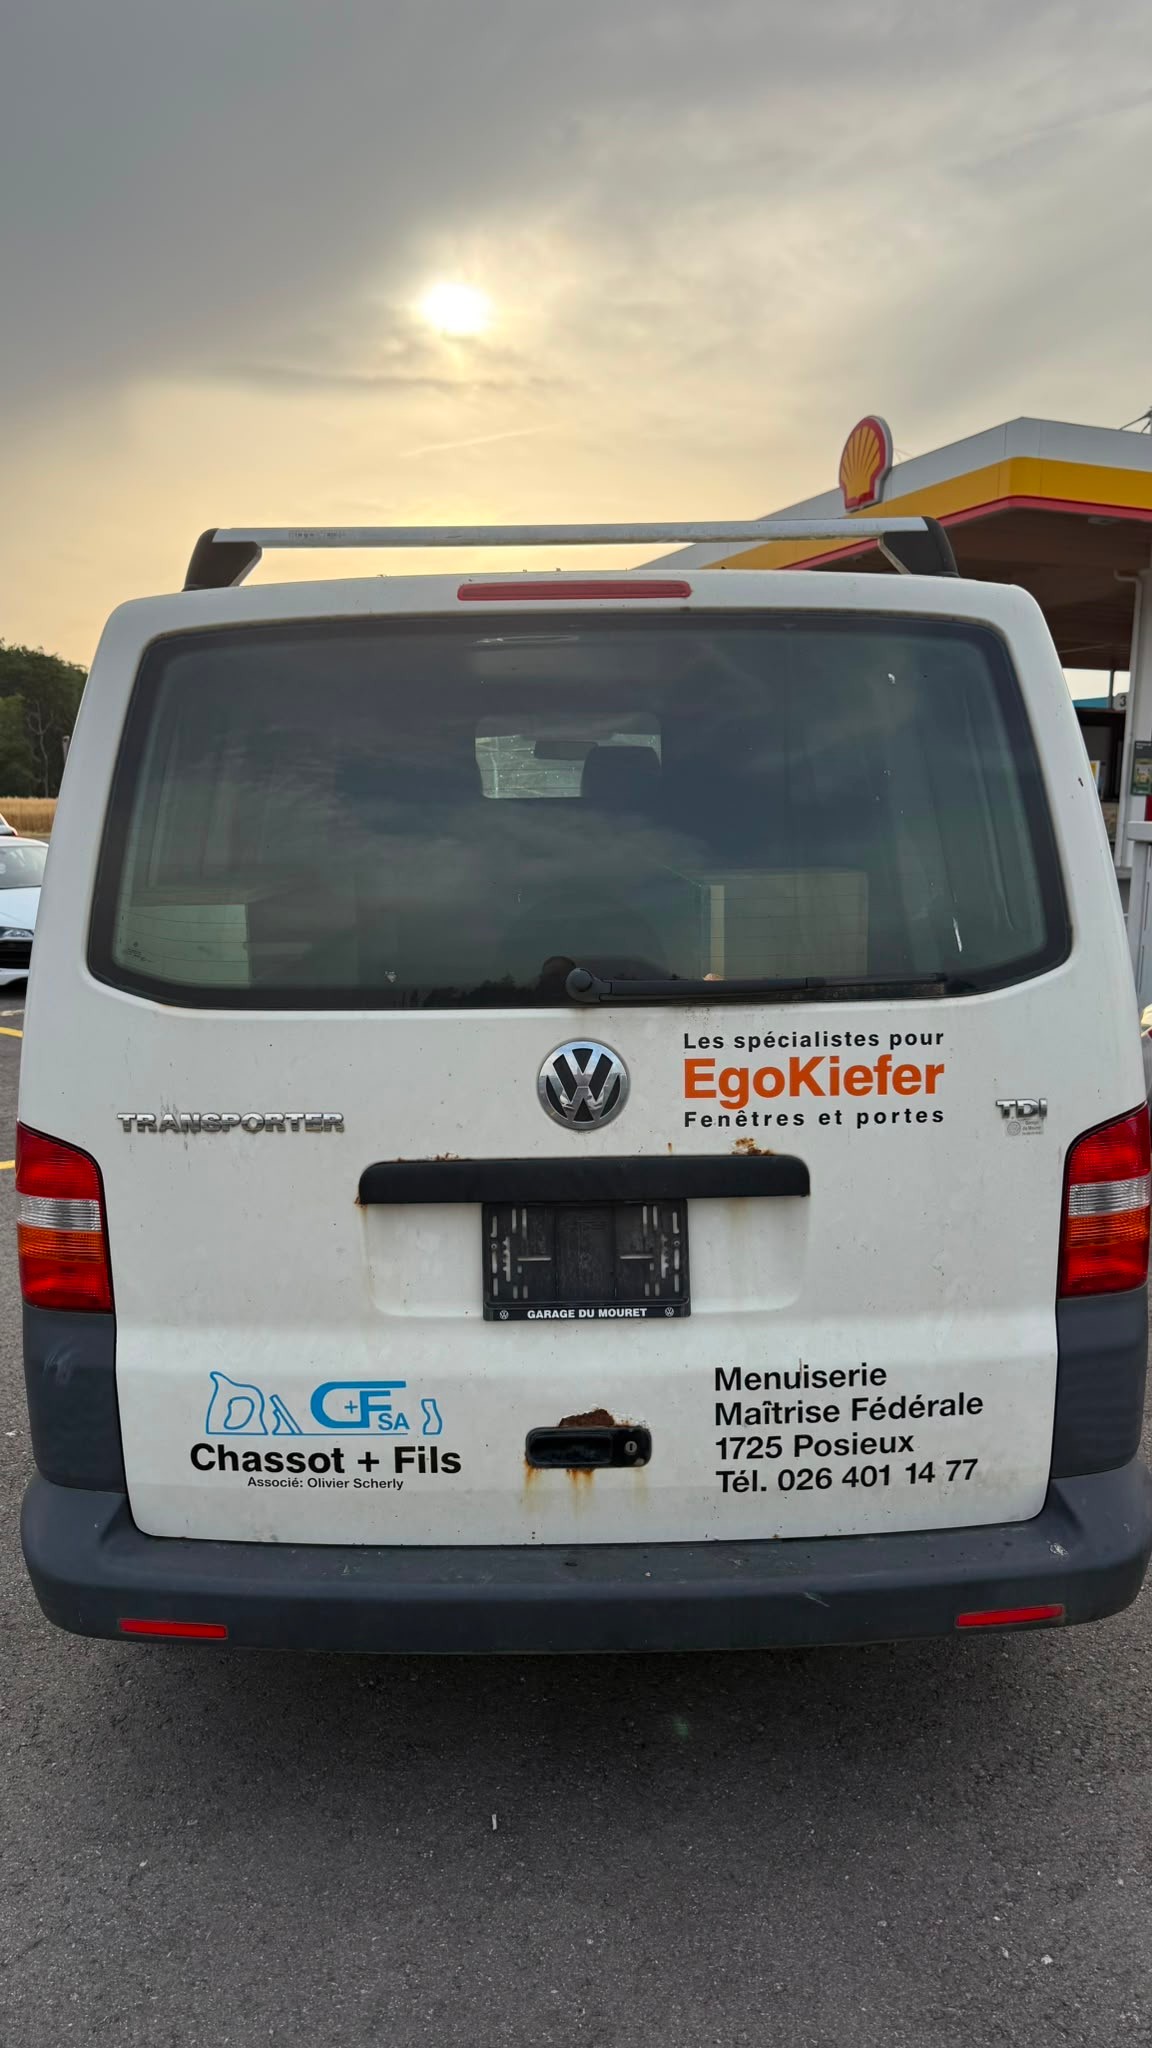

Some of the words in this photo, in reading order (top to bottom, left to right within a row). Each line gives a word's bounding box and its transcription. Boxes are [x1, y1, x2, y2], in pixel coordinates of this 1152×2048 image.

[684, 1032, 724, 1050] Les
[734, 1030, 880, 1052] spécialistes
[889, 1031, 944, 1051] pour
[683, 1054, 945, 1110] EgoKiefer
[684, 1110, 805, 1128] Fenêtres
[818, 1109, 843, 1126] et
[856, 1108, 944, 1129] portes
[996, 1098, 1048, 1119] TDI
[117, 1112, 345, 1134] TRANSPORTER
[527, 1309, 576, 1319] GARAGE
[578, 1309, 595, 1319] DU
[598, 1307, 648, 1318] MOURET
[714, 1362, 887, 1391] Menuiserie
[715, 1400, 841, 1426] Maîtrise
[851, 1392, 984, 1421] Fédérale
[190, 1442, 346, 1474] Chassot
[357, 1451, 380, 1473] +
[394, 1445, 462, 1474] Fils
[715, 1436, 783, 1460] 1725
[793, 1432, 915, 1458] Posieux
[247, 1476, 303, 1488] Associé:
[307, 1477, 350, 1489] Olivier
[353, 1477, 404, 1491] Scherly
[715, 1469, 768, 1493] Tél.
[777, 1468, 833, 1491] 026
[841, 1464, 890, 1488] 401
[905, 1462, 936, 1485] 14
[945, 1458, 979, 1482] 77
